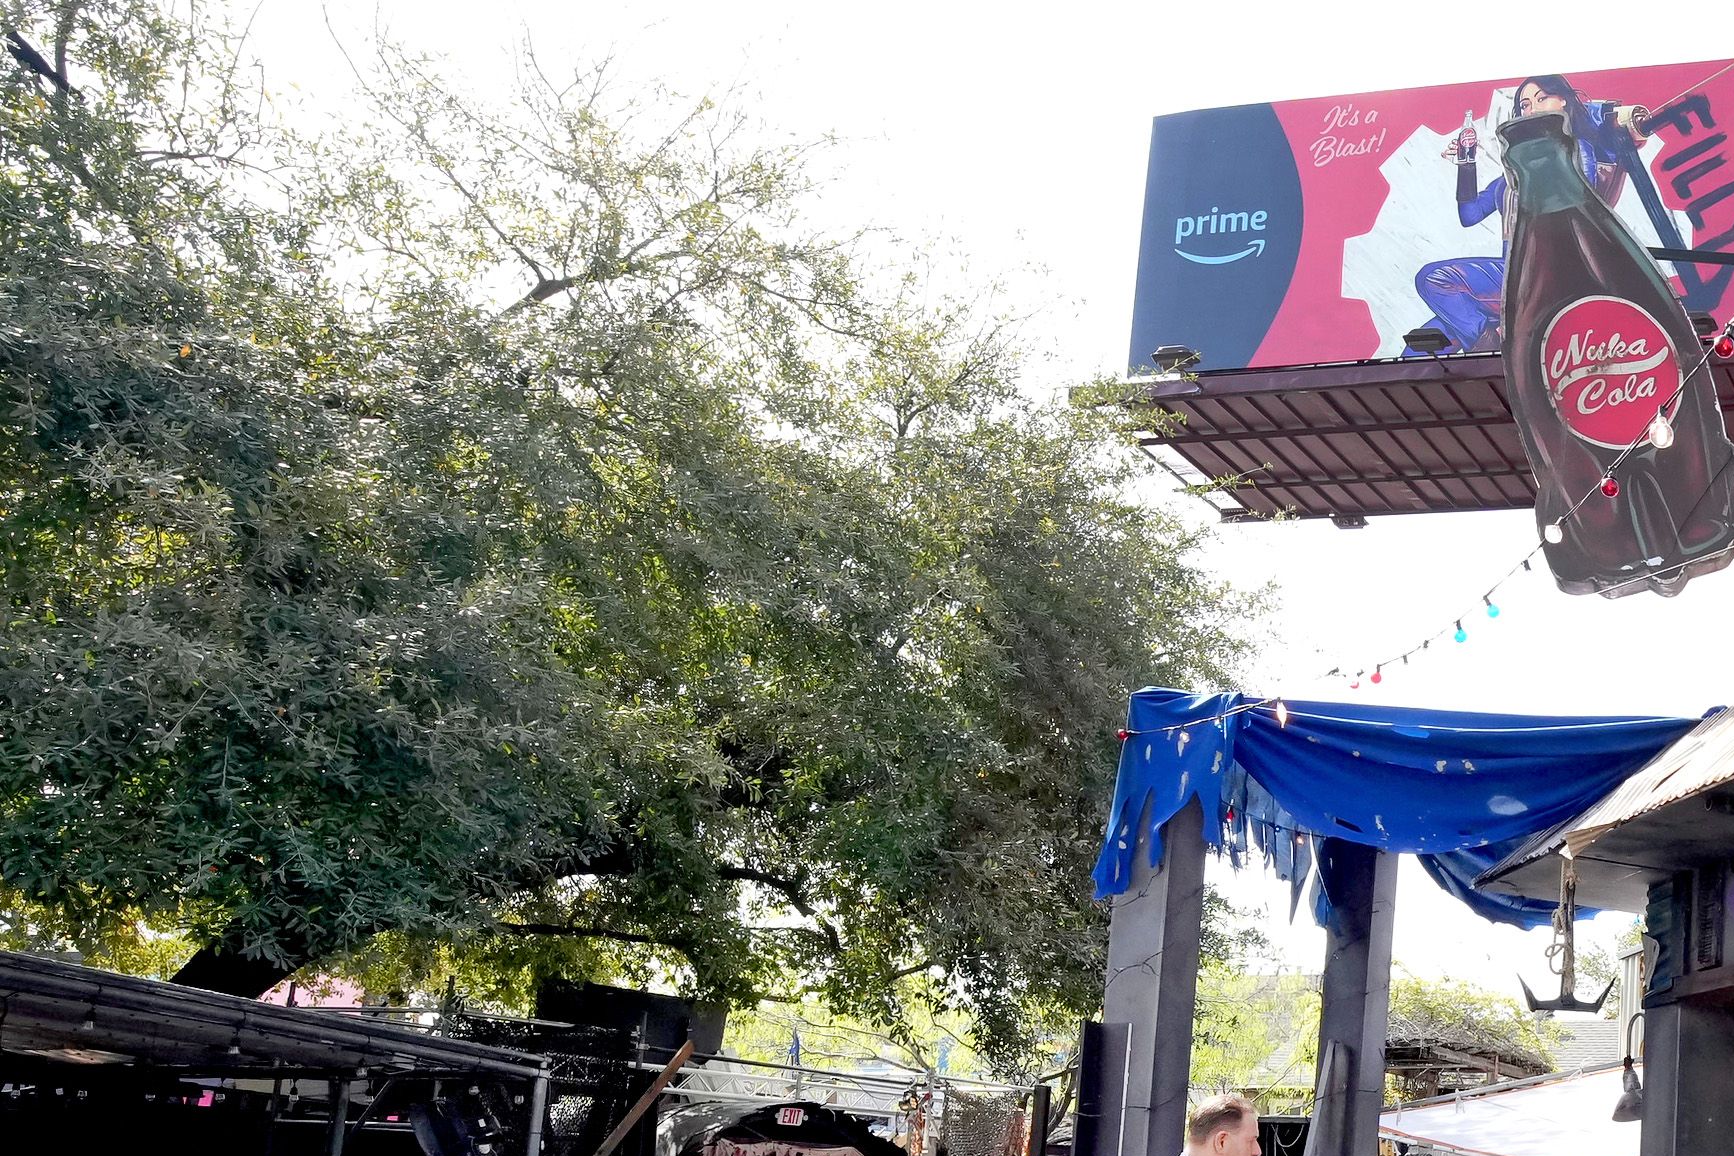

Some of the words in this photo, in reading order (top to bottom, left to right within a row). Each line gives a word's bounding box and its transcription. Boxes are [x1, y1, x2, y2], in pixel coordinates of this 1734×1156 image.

[1320, 104, 1359, 134] It's
[1364, 109, 1378, 123] a
[1310, 128, 1386, 167] Blast!
[1175, 207, 1268, 244] prime
[1550, 329, 1649, 378] Nuka
[1577, 374, 1657, 415] Cola
[782, 1108, 802, 1124] EXIT
